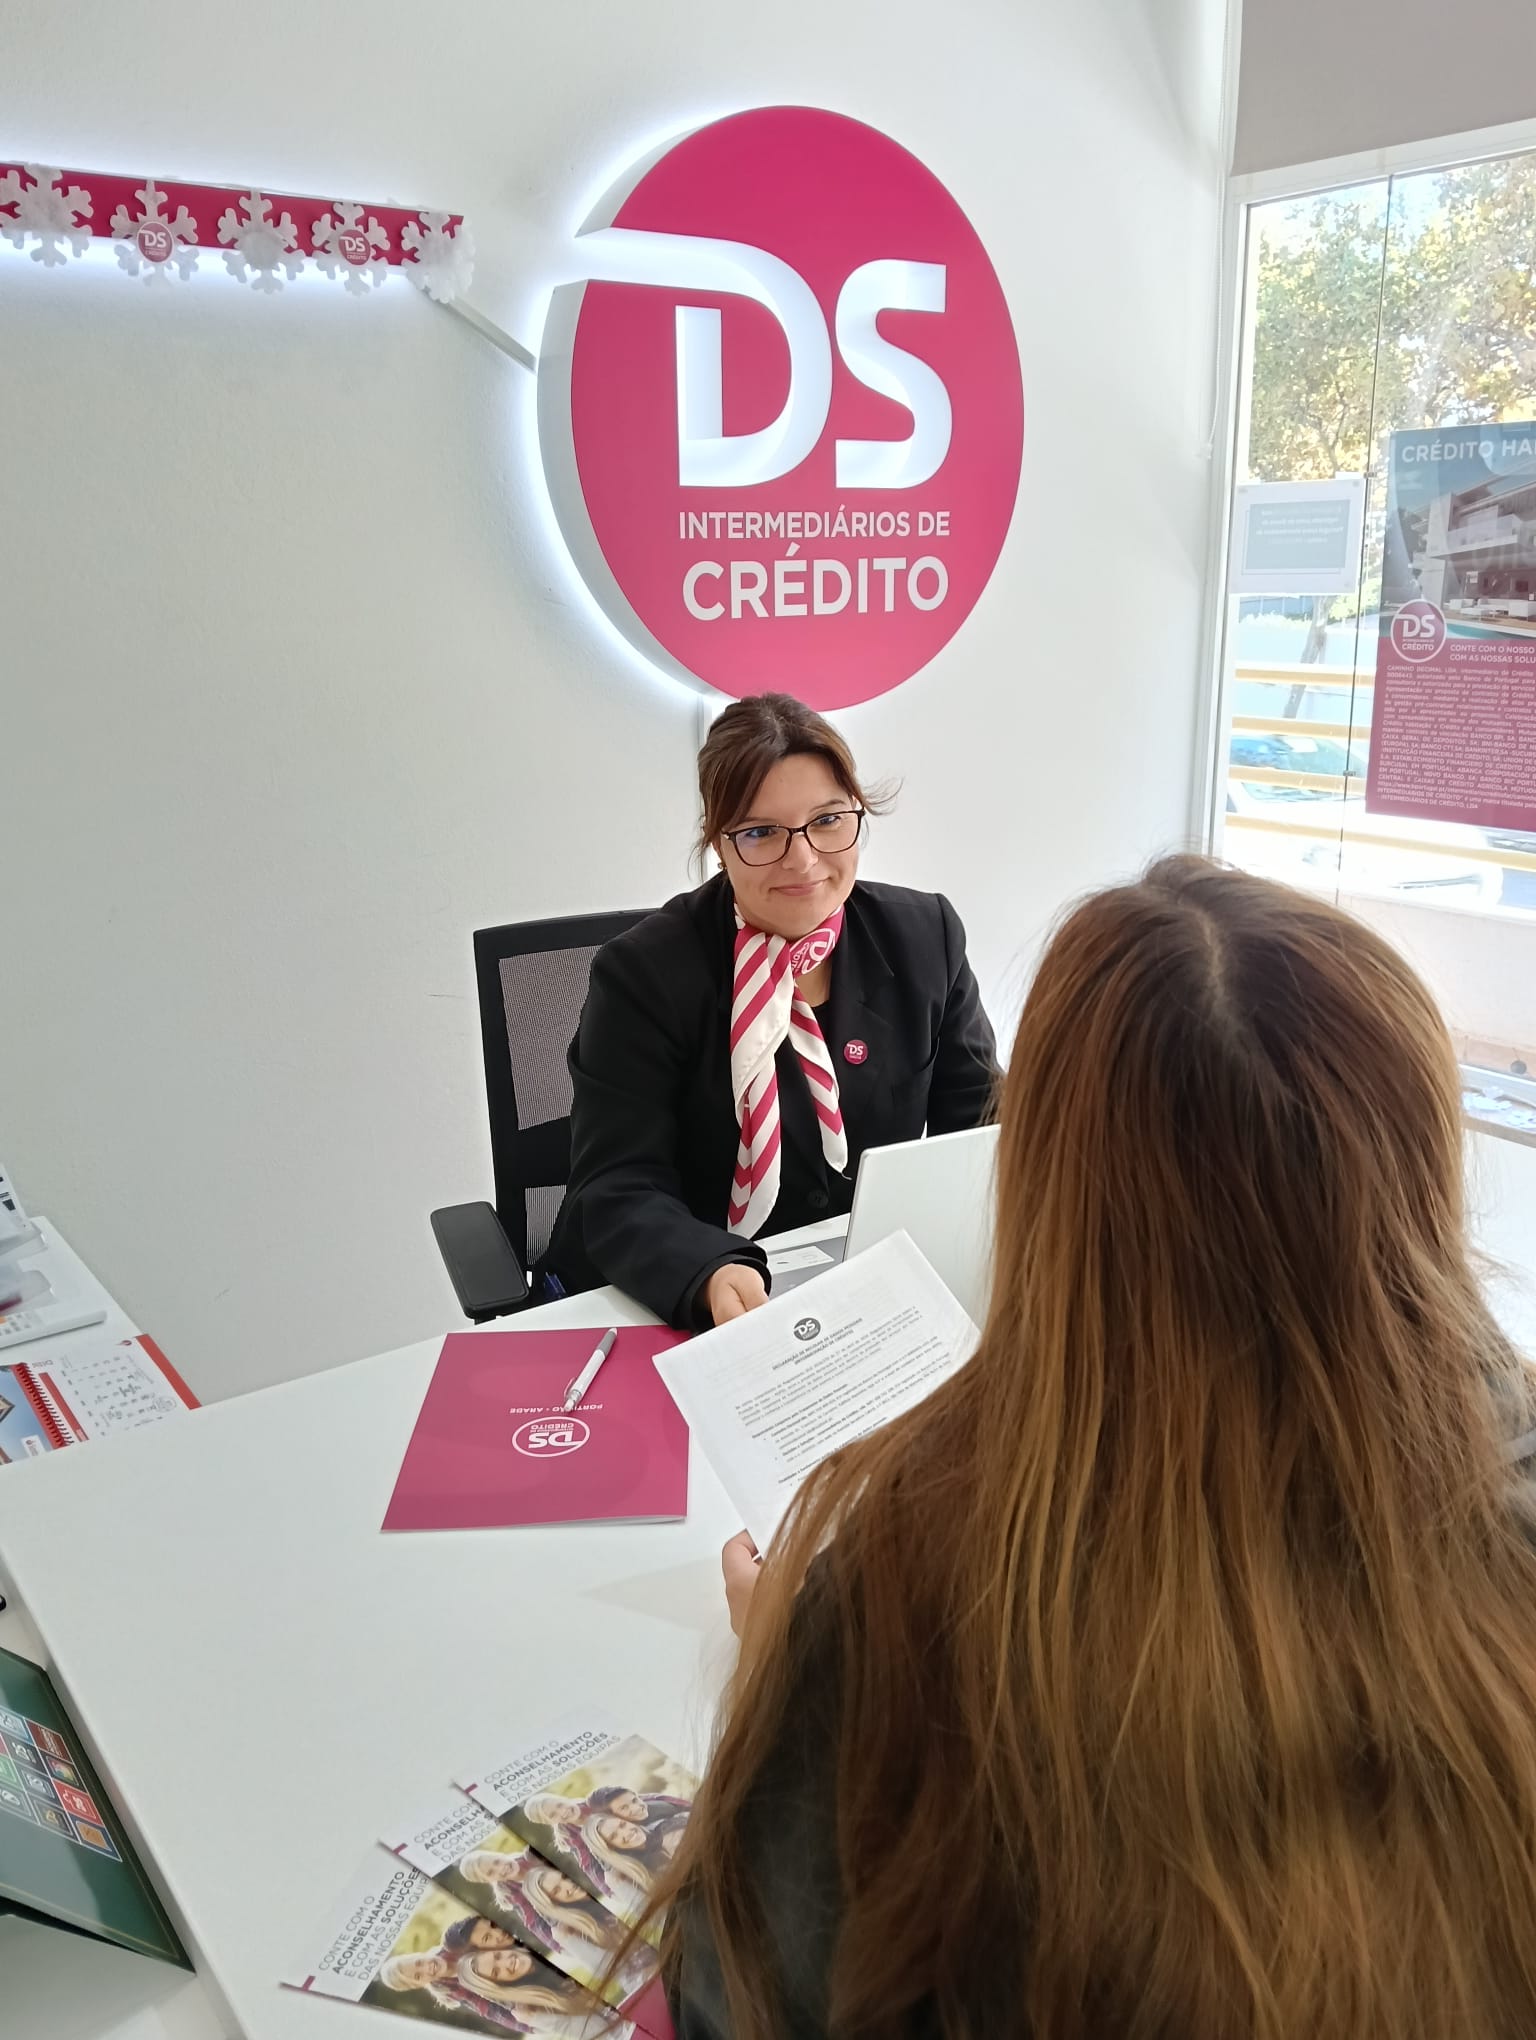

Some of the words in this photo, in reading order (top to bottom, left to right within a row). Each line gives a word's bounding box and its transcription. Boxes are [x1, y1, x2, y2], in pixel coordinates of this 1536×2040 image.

[140, 229, 167, 248] DS
[340, 236, 366, 252] DS
[592, 227, 952, 489] DS
[1401, 439, 1495, 463] CRÉDITO
[1502, 437, 1536, 457] HA
[678, 504, 911, 539] INTERMEDIÁRIOS
[917, 510, 951, 537] DE
[682, 543, 950, 621] CRÉDITO
[1400, 614, 1436, 638] DS
[1402, 642, 1434, 650] CRÉDITO
[1450, 644, 1477, 652] CONTE
[1506, 646, 1535, 654] NOSSO
[1480, 655, 1513, 663] NOSSAS
[846, 1043, 864, 1056] DS
[794, 1320, 816, 1335] DS
[552, 1404, 603, 1412] PORTIO
[528, 1430, 584, 1448] DS
[484, 1760, 520, 1784] CONTE
[523, 1746, 549, 1762] COM
[549, 1740, 560, 1748] O
[493, 1731, 593, 1791] ACONSELHAMENTO
[500, 1789, 510, 1798] E
[510, 1774, 535, 1792] COM
[538, 1765, 553, 1776] AS
[552, 1732, 608, 1767] SOLUÇÕES
[508, 1788, 532, 1804] DAS
[532, 1763, 576, 1789] NOSSAS
[575, 1735, 621, 1764] EQUIPAS
[414, 1816, 452, 1843] CONTE
[432, 1848, 442, 1856] E
[442, 1831, 468, 1850] COM
[470, 1819, 486, 1832] AS
[440, 1846, 466, 1863] DAS
[464, 1823, 496, 1846] NOSS
[318, 1932, 350, 1971] CONTE
[346, 1906, 368, 1932] COM
[363, 1895, 375, 1905] O
[332, 1871, 404, 1974] ACONSELHAMENTO
[344, 1969, 356, 1978] E
[352, 1942, 375, 1968] COM
[370, 1926, 386, 1941] AS
[358, 1958, 380, 1981] DAS
[374, 1912, 409, 1958] NOSSAS
